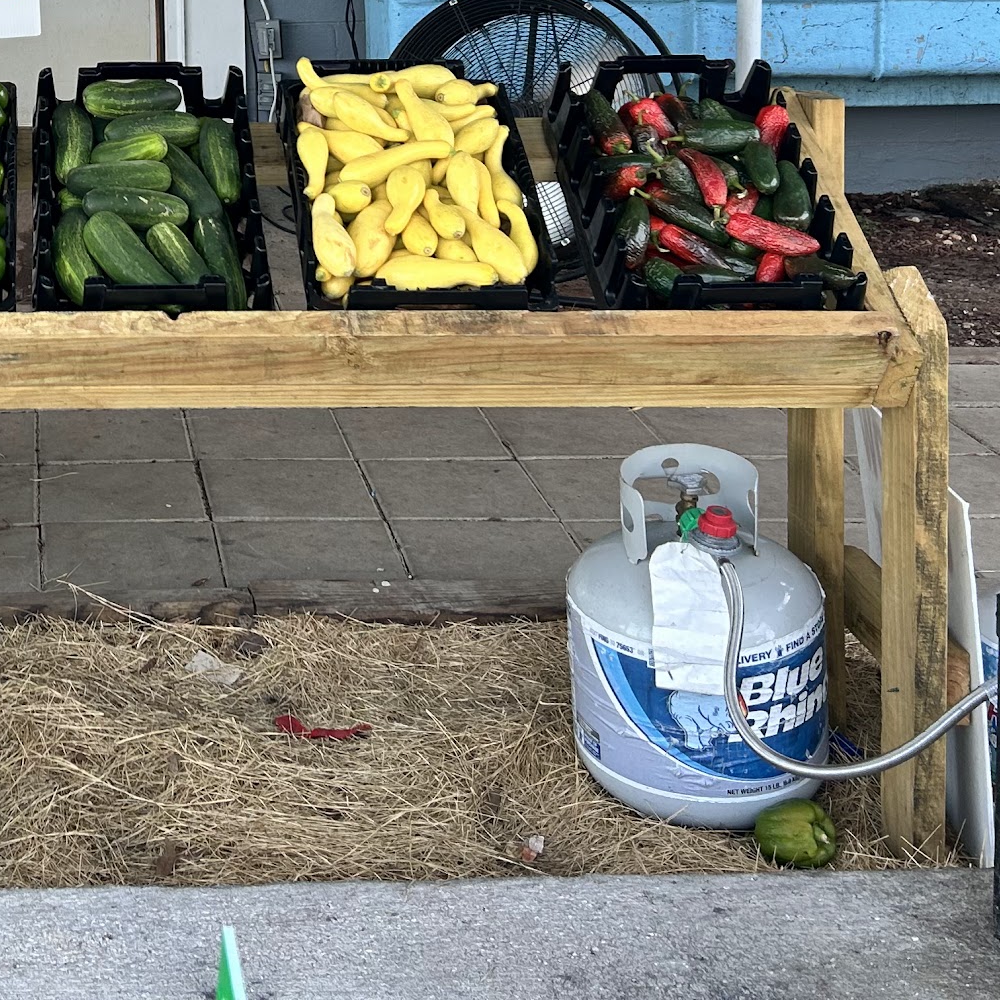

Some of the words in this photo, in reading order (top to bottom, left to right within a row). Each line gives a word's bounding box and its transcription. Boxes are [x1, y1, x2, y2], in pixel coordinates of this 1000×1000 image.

[785, 634, 804, 653] FIND
[740, 646, 824, 706] Blue
[740, 786, 763, 795] WEIGHT
